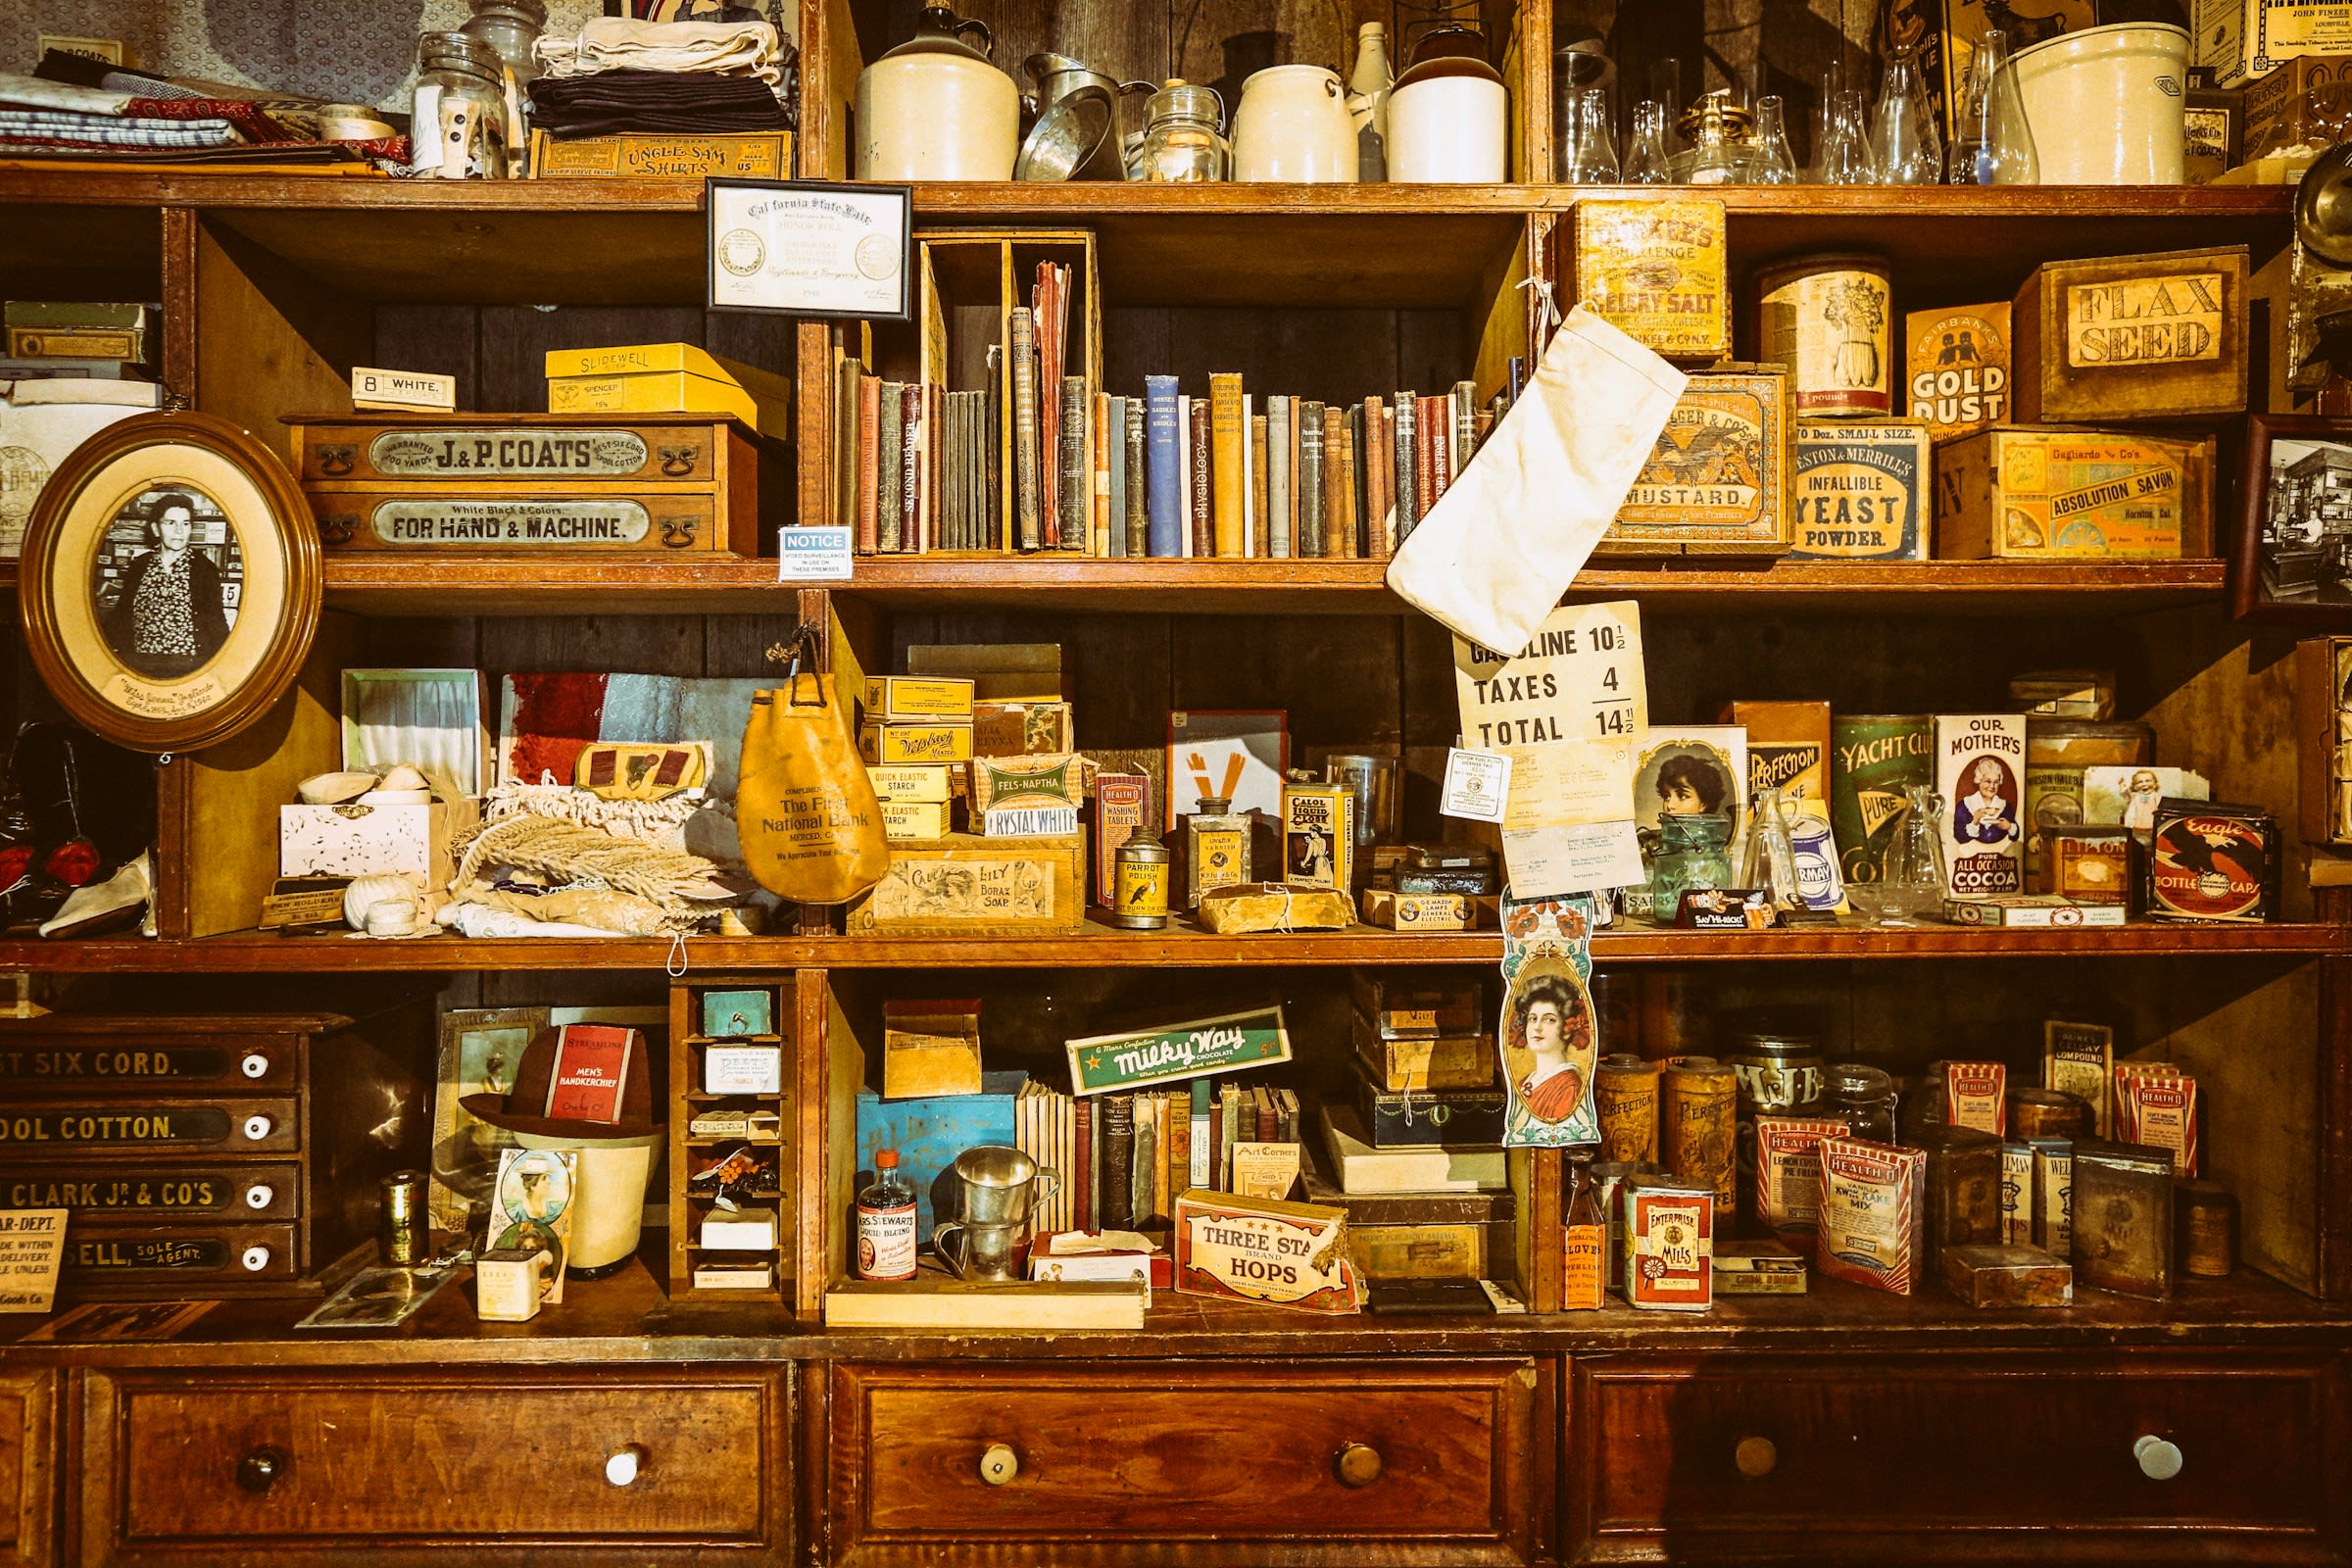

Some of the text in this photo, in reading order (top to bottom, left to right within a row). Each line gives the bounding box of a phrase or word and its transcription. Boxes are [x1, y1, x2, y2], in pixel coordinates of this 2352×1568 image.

[690, 148, 725, 166] SAM
[635, 161, 708, 175] SHIRTS
[1667, 293, 1715, 314] SALT
[2079, 277, 2222, 323] FLAX
[2080, 321, 2211, 362] SEED
[581, 353, 649, 372] SLIDEWELL
[365, 376, 439, 393] 8 WHITE.
[1912, 366, 2006, 398] GOLD
[1812, 393, 1848, 403] pounds
[1912, 394, 2004, 424] DUST
[1710, 415, 1719, 426] &
[1813, 428, 1916, 440] Doz. SMALL SIZE.
[384, 440, 433, 455] WARRANTED
[625, 441, 644, 455] CORD
[405, 456, 431, 467] YARDS
[595, 454, 643, 467] SPOOL COTTON
[1796, 449, 1838, 470] ESTON
[905, 422, 917, 513] SECOND READER
[1197, 442, 1208, 518] PHYSIOLOGY
[1808, 476, 1882, 491] INFALLIBLE
[1625, 490, 1746, 506] MUSTARD.
[2054, 470, 2175, 515] ABSOLUTION SAVON
[452, 506, 484, 515] White
[1796, 497, 1899, 524] YEAST
[394, 516, 627, 539] FOR HAND & MACHINE.
[787, 535, 843, 548] NOTICE
[1805, 530, 1886, 547] POWDER.
[1471, 628, 1578, 664] GALINE
[1474, 666, 1619, 705] TAXES 4
[1479, 715, 1563, 748] TOTAL
[1969, 719, 2004, 732] OUR
[901, 730, 955, 757] Welsbach
[1951, 734, 2021, 756] MOTHER'S
[1840, 735, 1905, 773] YACHT
[1748, 747, 1815, 789] PERFECTION
[875, 772, 928, 782] QUICK ELASTIC
[998, 777, 1058, 792] FELS-NAPTHA
[888, 781, 915, 791] STARCH
[780, 799, 808, 813] The
[1292, 797, 1326, 807] CALOL
[1862, 795, 1898, 823] PURE
[892, 807, 920, 816] ELASTIC
[1106, 807, 1138, 815] WASHING
[1293, 807, 1329, 816] LIQUID
[762, 812, 869, 834] National Bank
[885, 816, 906, 825] TARCH
[1038, 808, 1075, 834] WHITE
[1107, 815, 1138, 825] TABLETS
[2186, 818, 2244, 837] Eagle
[980, 864, 1009, 882] LILY
[1957, 859, 2016, 872] ALL OCCASION
[1953, 871, 2018, 887] COCOA
[2155, 876, 2261, 894] BOTTLE CAPS
[981, 884, 1010, 896] BORAX
[1102, 1038, 1156, 1054] Mars Confection
[1113, 1026, 1246, 1076] Milky Way
[1196, 1049, 1235, 1061] CHOCOLATE
[2056, 1052, 2103, 1063] COMPOUND
[35, 1052, 178, 1075] SIX CORD.
[576, 1067, 604, 1077] MEN'S
[560, 1076, 617, 1088] HANDKERCHIEF
[61, 1115, 175, 1140] COTTON.
[1238, 1146, 1297, 1156] Art Corners
[1774, 1156, 1798, 1166] LEMON
[11, 1182, 214, 1206] CLARK & CO'S
[1847, 1182, 1880, 1194] VANILLA
[1850, 1199, 1873, 1210] MIX
[1862, 1193, 1890, 1205] KAKE
[1651, 1213, 1694, 1227] ENTERPRISE
[19, 1241, 54, 1250] WITHIN
[1202, 1226, 1312, 1256] THREE STA
[137, 1242, 173, 1256] SOLE
[157, 1249, 201, 1264] AGENT.
[1246, 1250, 1283, 1261] BRAND
[1662, 1245, 1691, 1265] MILLS
[1231, 1258, 1298, 1285] HOPS
